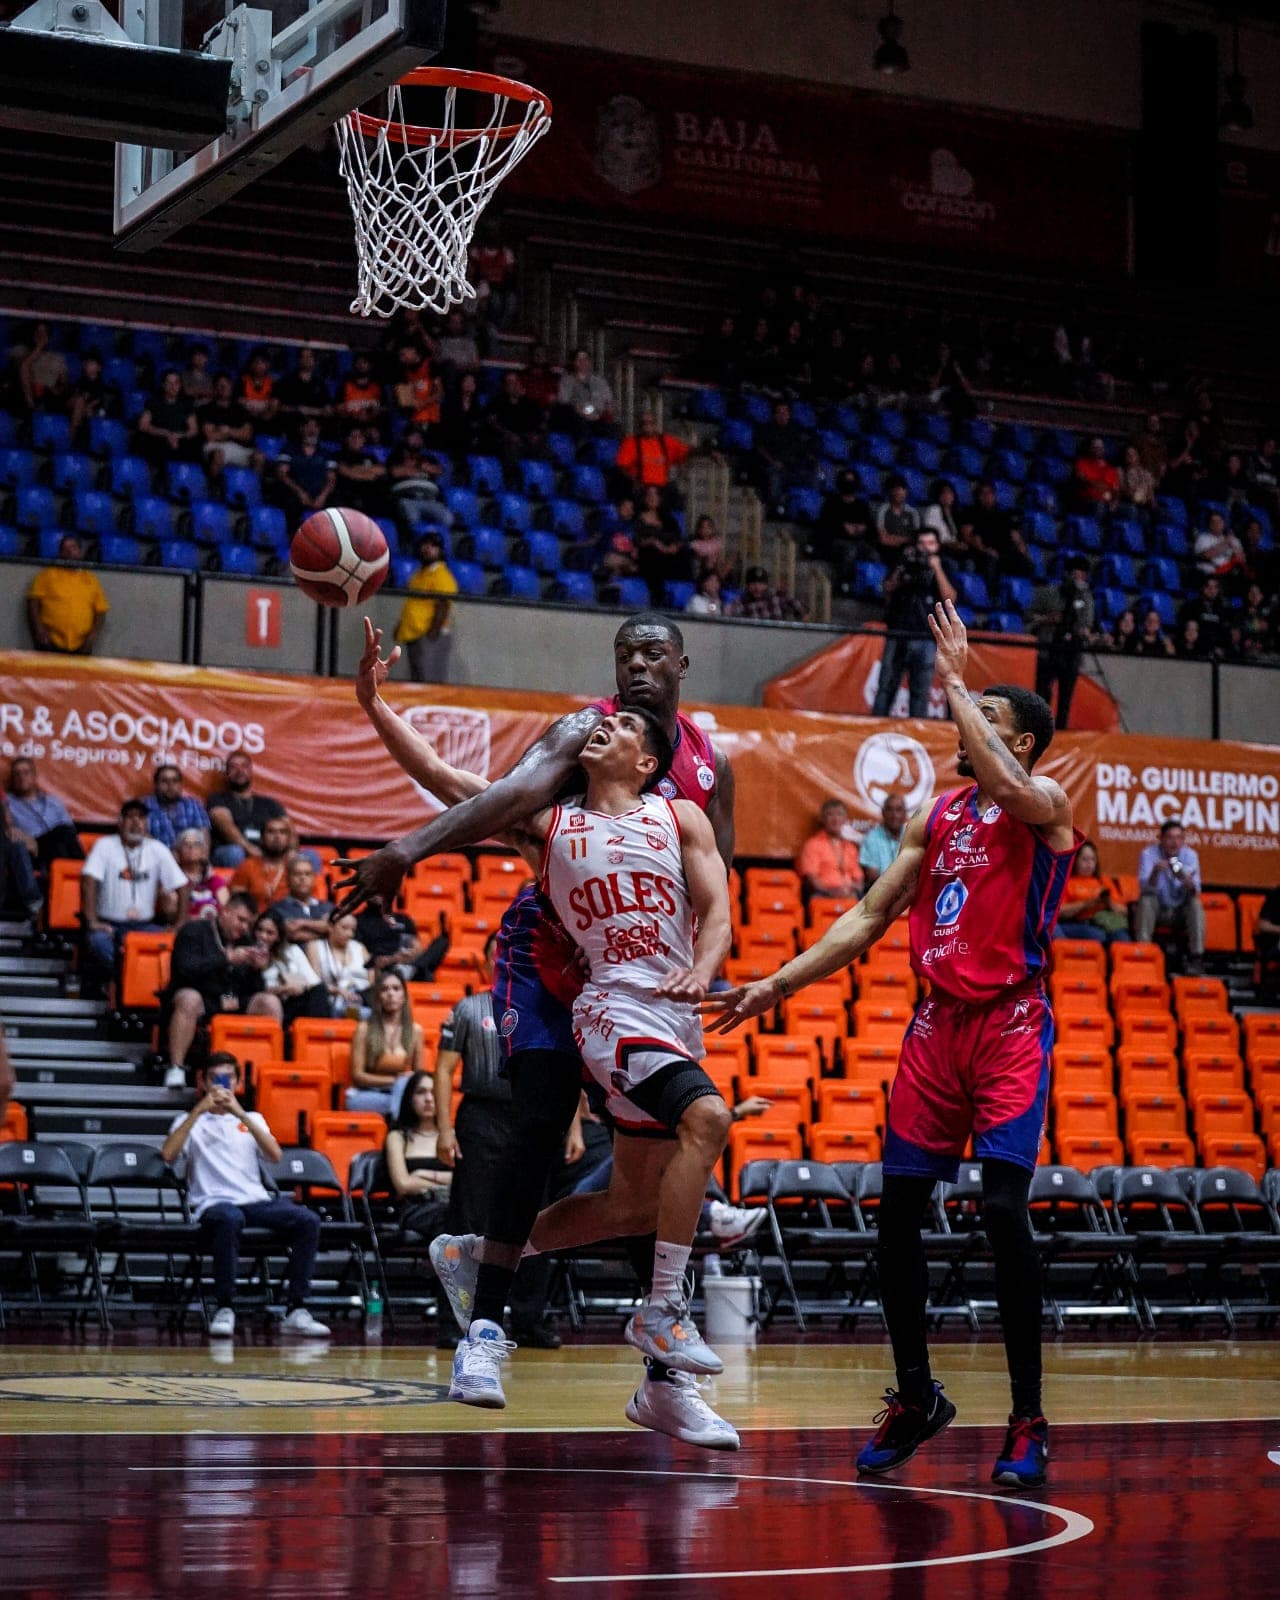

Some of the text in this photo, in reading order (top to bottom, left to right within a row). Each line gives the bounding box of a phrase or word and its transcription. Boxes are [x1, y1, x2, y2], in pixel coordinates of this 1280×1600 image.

[674, 111, 781, 154] BAJA
[673, 146, 822, 182] CALIFORNIA
[31, 705, 54, 736] &
[61, 709, 265, 754] ASOCIADOS
[50, 739, 130, 768] Seguros
[1096, 762, 1279, 799] DR. GUILLERMO
[1096, 789, 1280, 834] MACALPIN
[570, 837, 587, 861] 11
[569, 871, 676, 931] SOLES
[604, 919, 660, 947] Facial
[603, 939, 671, 965] Quality
